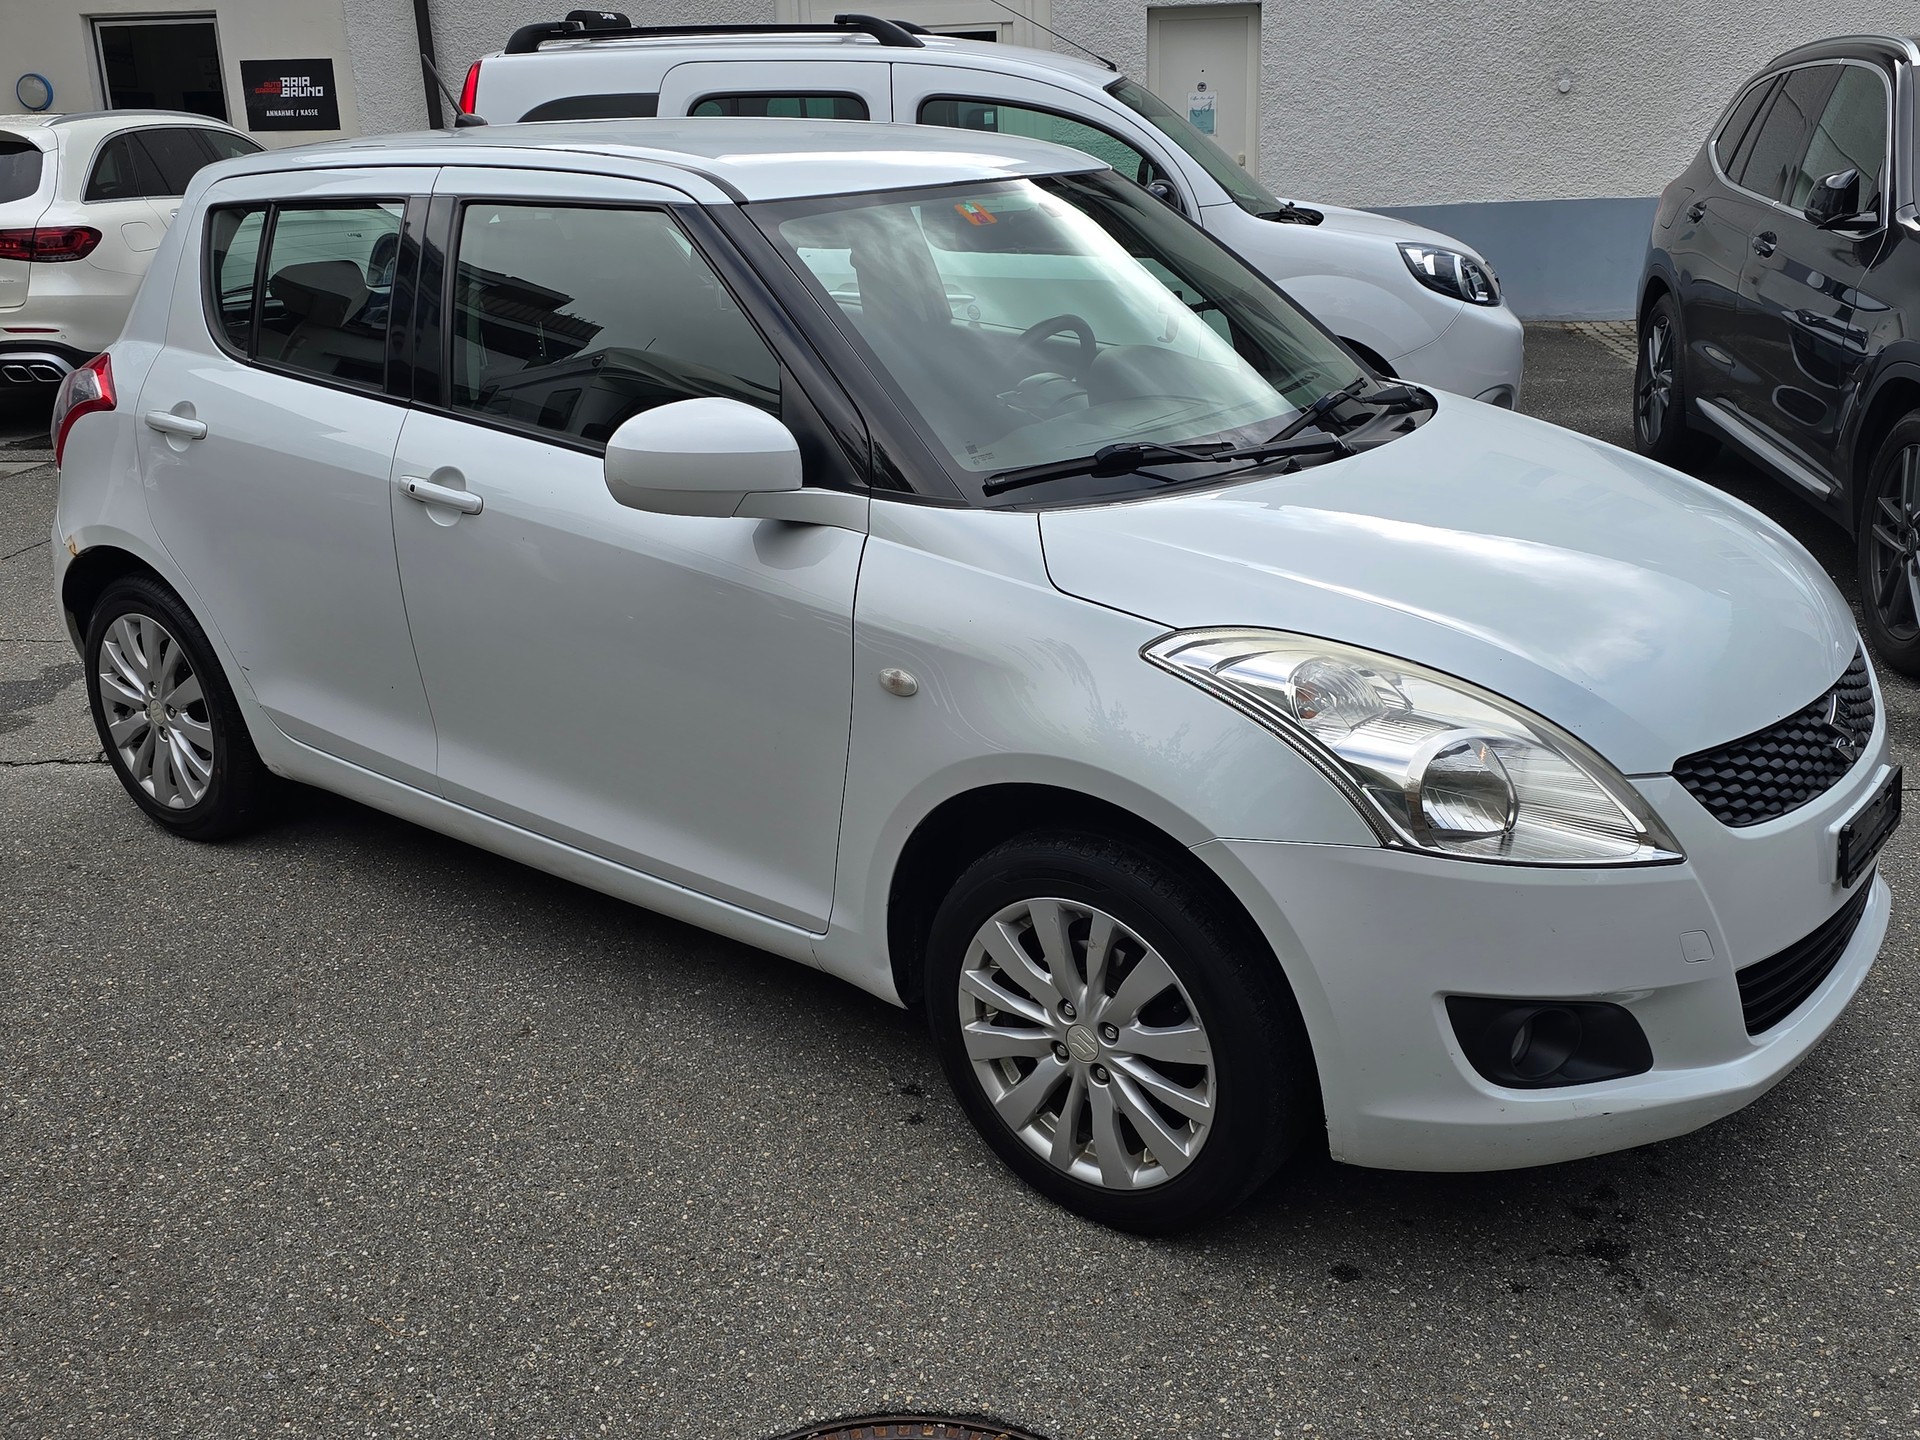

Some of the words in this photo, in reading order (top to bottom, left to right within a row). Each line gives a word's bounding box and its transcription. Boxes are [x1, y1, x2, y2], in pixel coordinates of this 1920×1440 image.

[280, 76, 310, 87] ARIA
[280, 86, 324, 98] BRUNO
[266, 109, 295, 117] ANNAHME
[300, 108, 319, 116] KASSE
